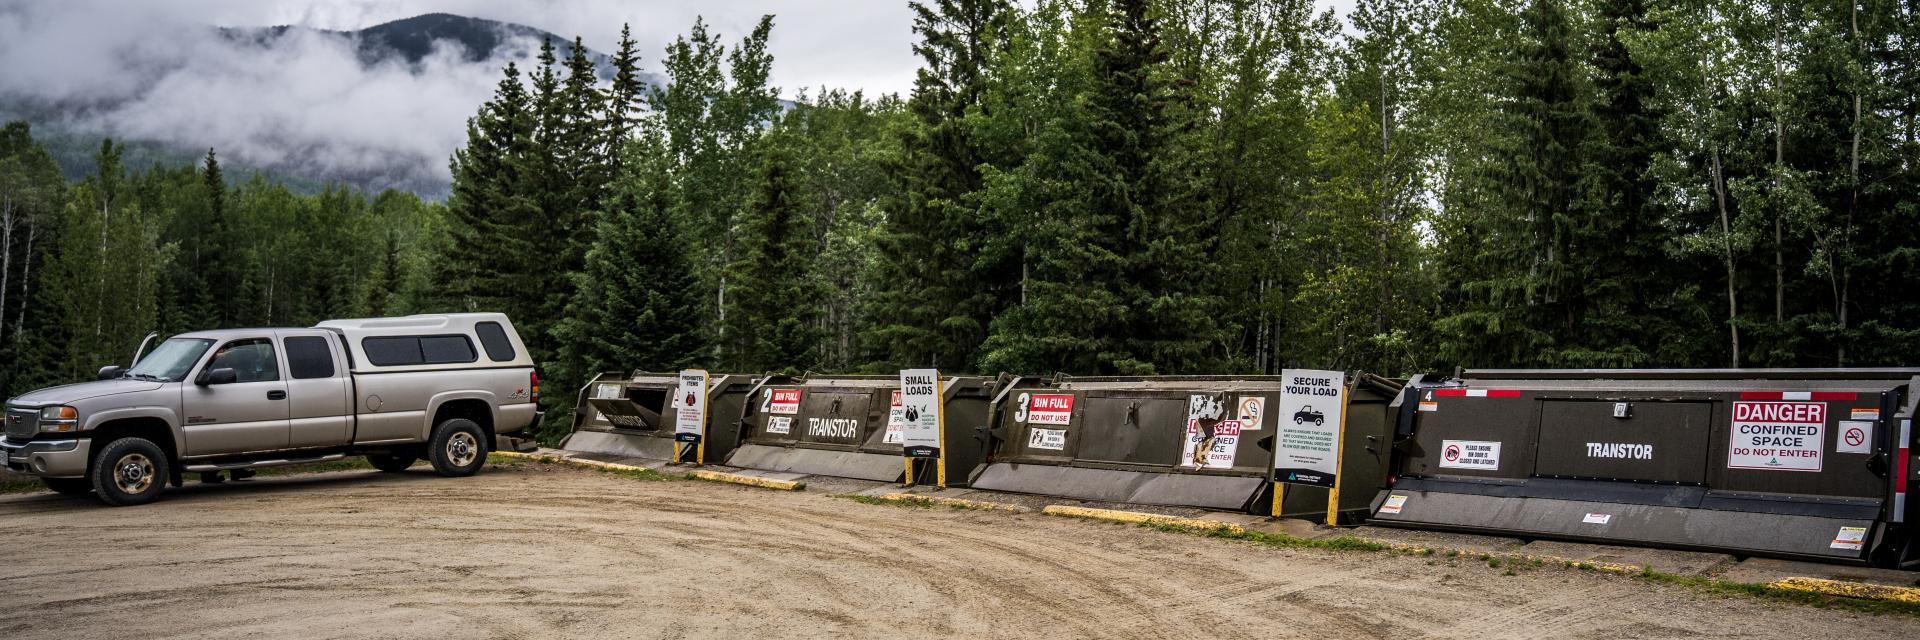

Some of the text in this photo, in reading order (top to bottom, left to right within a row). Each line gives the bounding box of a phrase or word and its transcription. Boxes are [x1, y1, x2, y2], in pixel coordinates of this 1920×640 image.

[905, 376, 933, 385] SMALL
[1294, 377, 1330, 386] SECURE
[906, 386, 933, 395] LOADS
[1286, 386, 1337, 396] YOUR LOAD
[760, 388, 772, 412] 2
[1425, 391, 1431, 401] 4
[1014, 392, 1029, 422] 3
[1034, 398, 1069, 408] BIN FULL
[1737, 403, 1821, 422] DANGER
[808, 417, 858, 438] TRANSTOR
[1740, 424, 1818, 436] CONFINED
[1752, 436, 1803, 447] SPACE
[1586, 442, 1653, 460] TRANSTOR
[1753, 448, 1776, 456] NOT
[1779, 449, 1818, 458] ENTER
